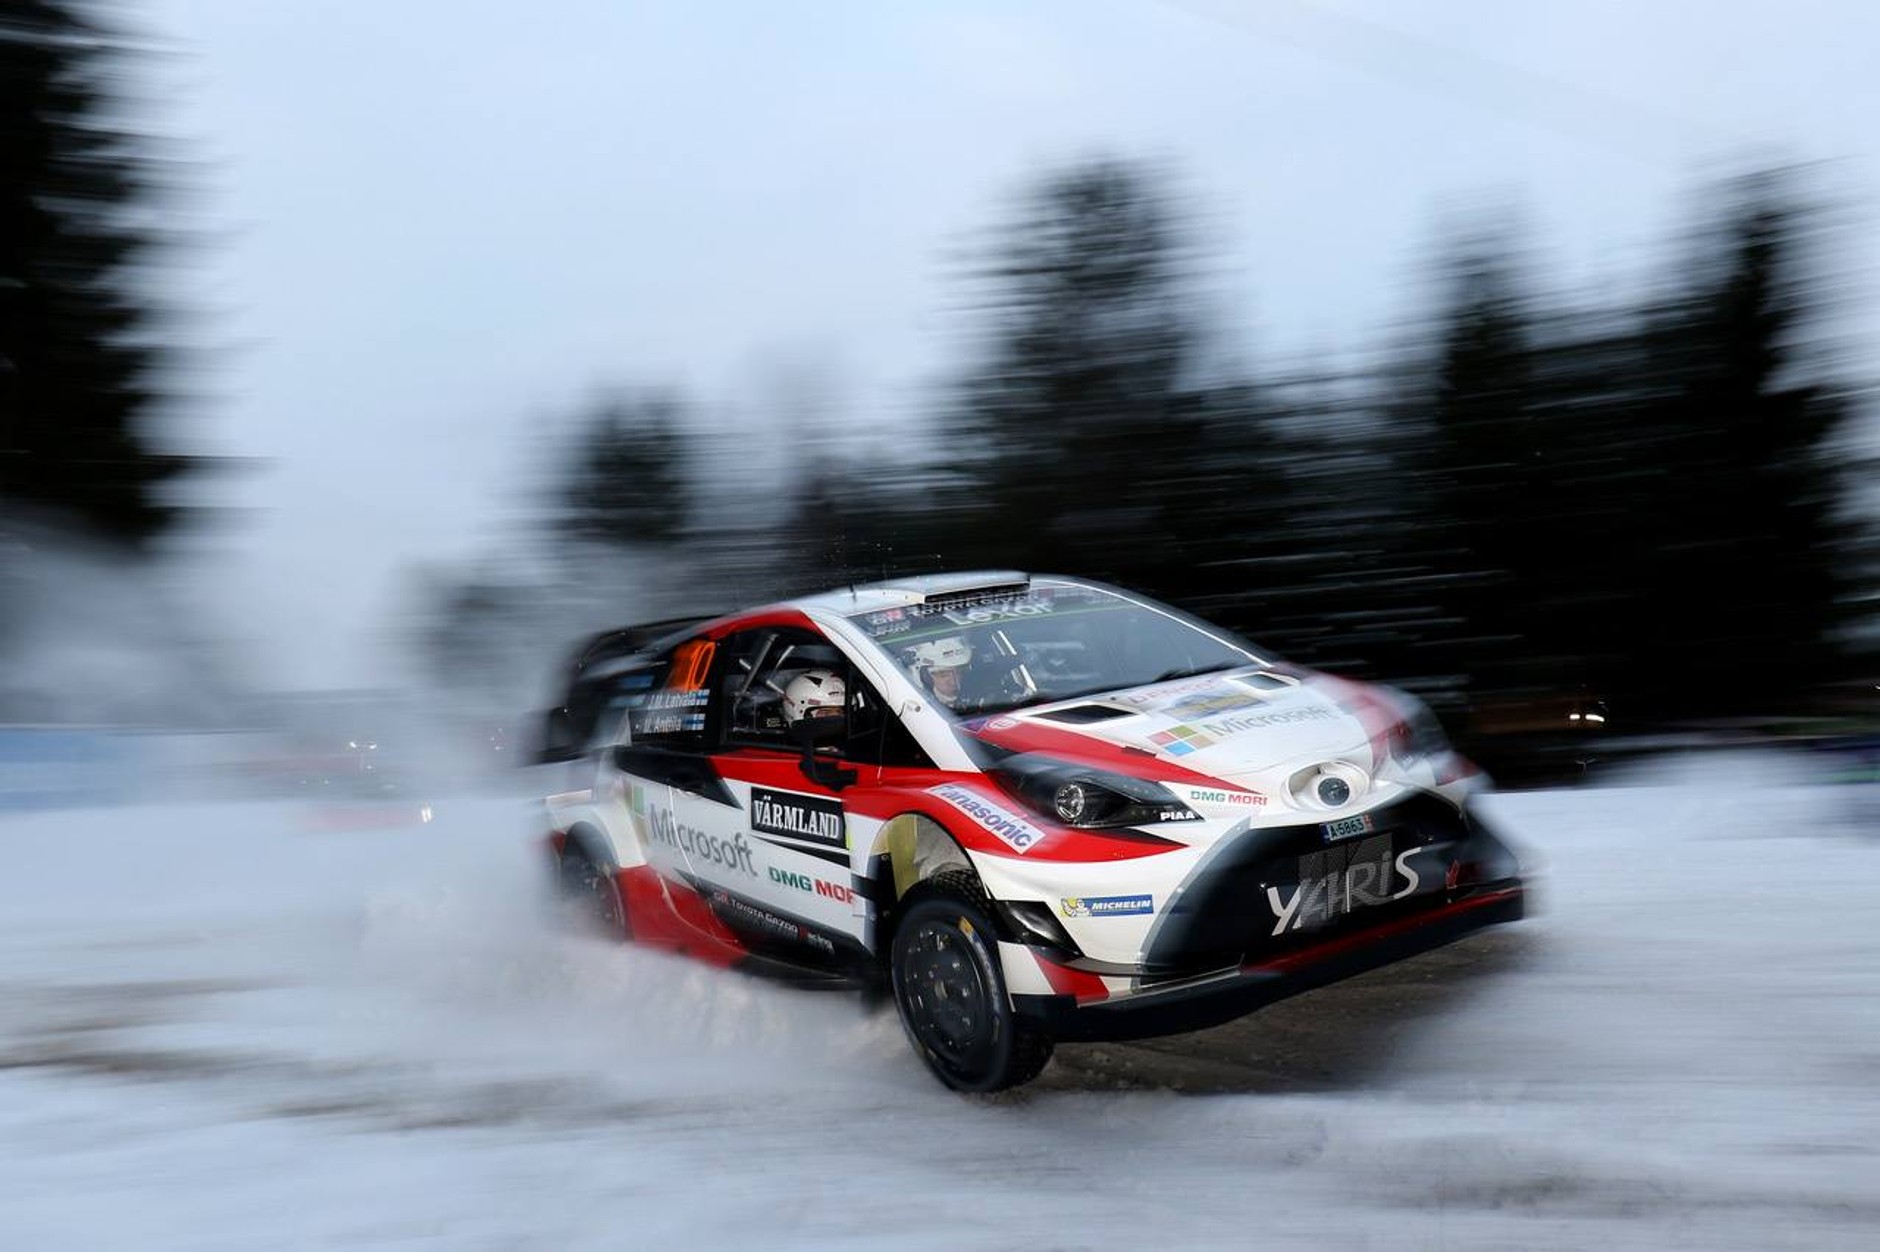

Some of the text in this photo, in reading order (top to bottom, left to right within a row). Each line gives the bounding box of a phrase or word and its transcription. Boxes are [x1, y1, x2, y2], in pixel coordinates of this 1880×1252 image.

[943, 600, 1053, 626] Lexar
[685, 641, 717, 693] 10
[1203, 704, 1332, 737] Microsoft
[1190, 790, 1268, 806] DMG MORI
[754, 795, 840, 840] VÄRMLAND
[930, 785, 1033, 847] Panasonic
[1160, 811, 1196, 821] PIAA
[650, 803, 758, 877] Microsoft
[769, 866, 813, 892] DMG
[1092, 899, 1151, 911] MICHELIN
